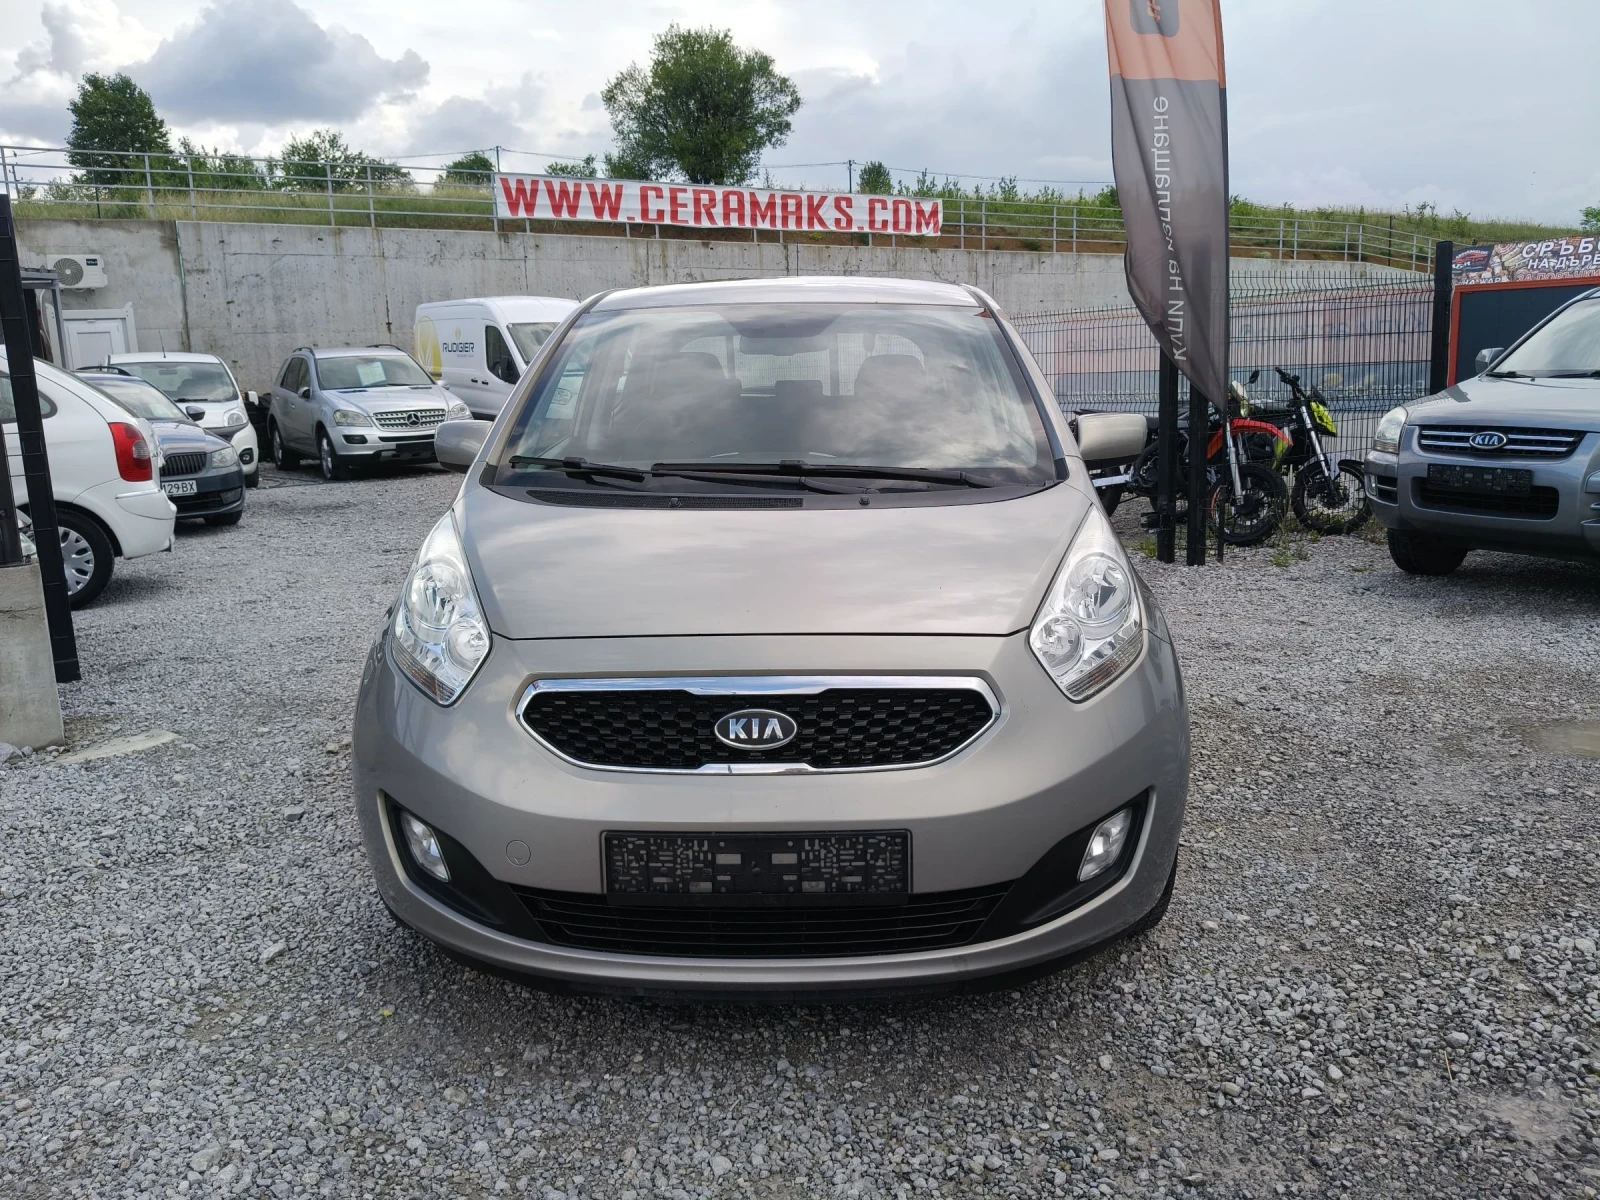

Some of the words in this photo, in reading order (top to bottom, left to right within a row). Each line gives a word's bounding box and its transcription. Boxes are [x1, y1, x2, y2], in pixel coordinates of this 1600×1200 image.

[498, 176, 941, 234] WWW.CERAMAKS.COM
[1522, 237, 1600, 258] СРЪБ
[442, 342, 475, 353] RUDIGIER
[1474, 435, 1498, 445] KIA
[728, 717, 784, 739] KIA
